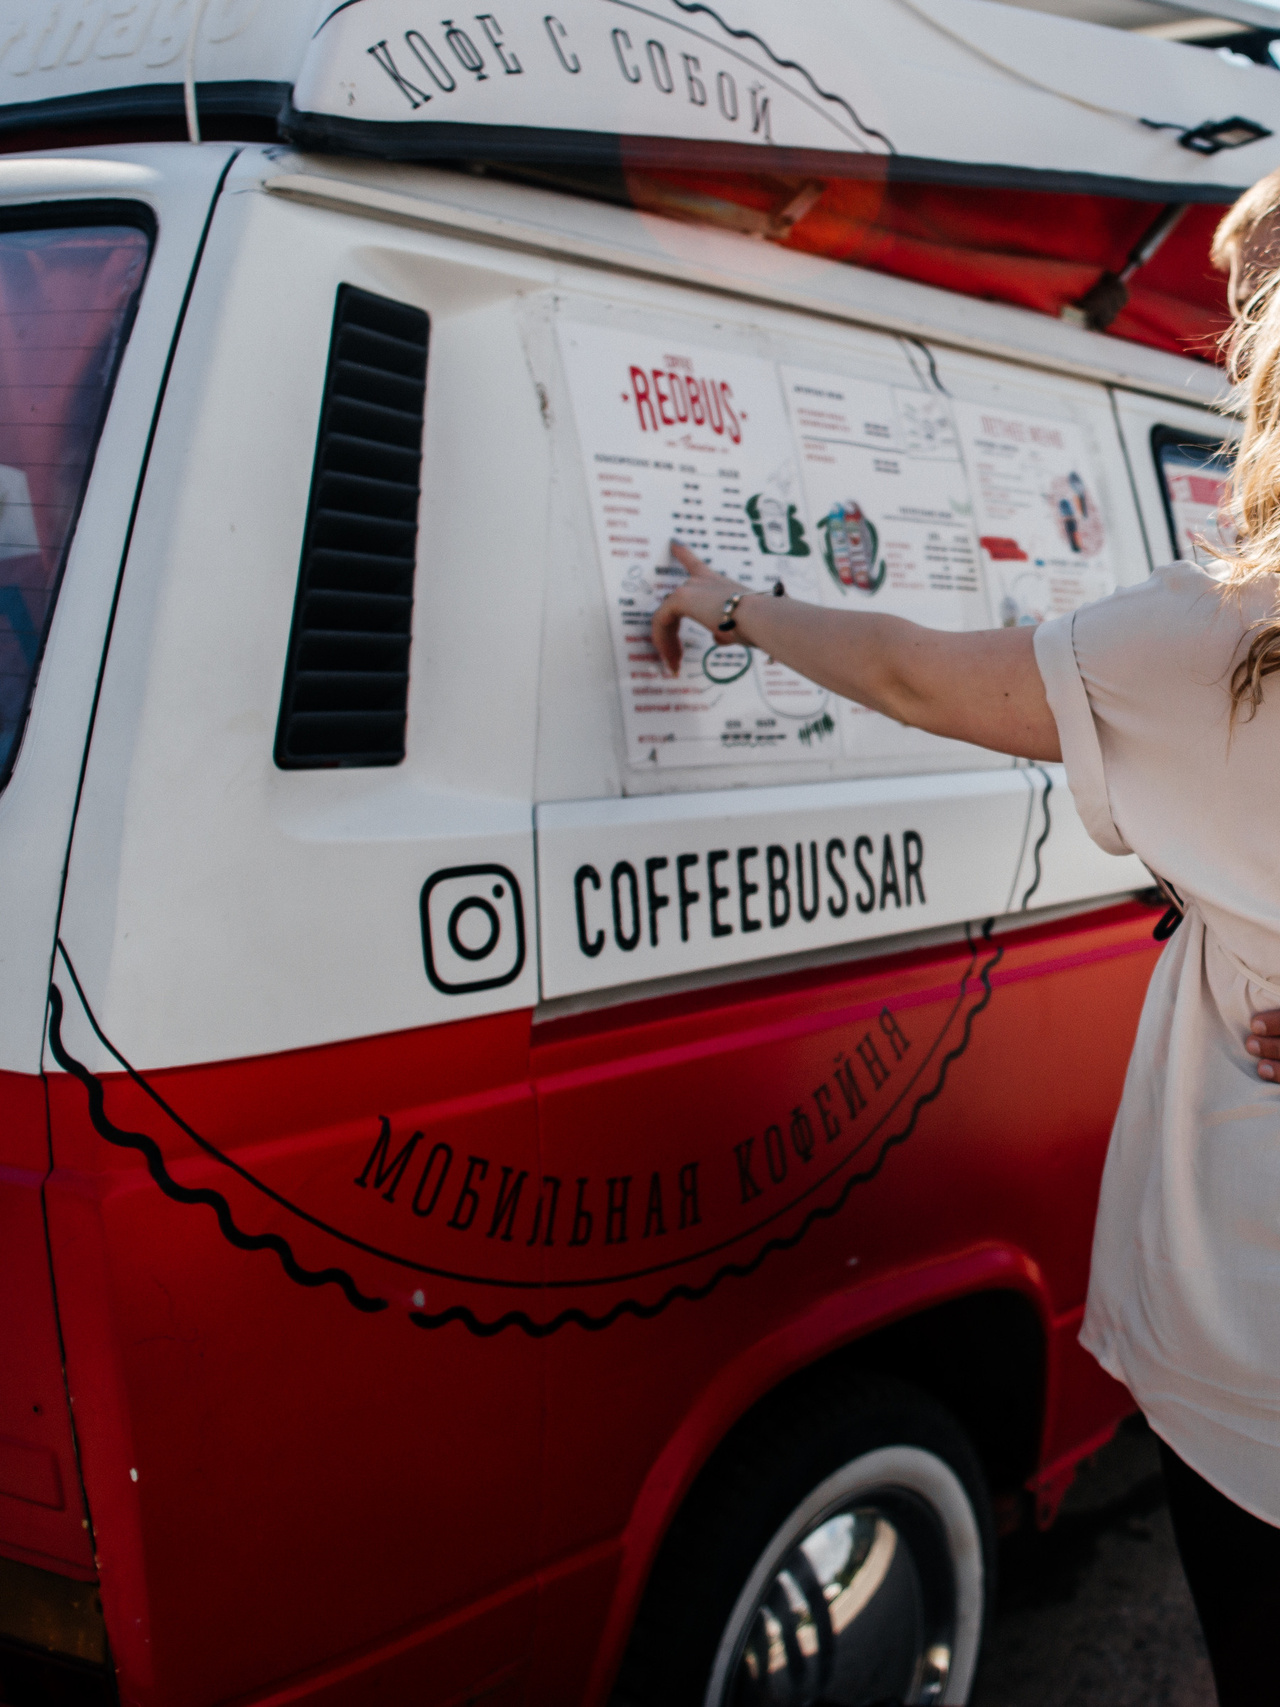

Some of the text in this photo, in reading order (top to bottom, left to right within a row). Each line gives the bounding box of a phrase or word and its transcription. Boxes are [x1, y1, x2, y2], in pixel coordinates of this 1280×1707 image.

[366, 13, 775, 145] КОФЕ С СОБОЙ
[629, 364, 742, 445] REDBUS
[573, 829, 927, 958] COFFEEBUSSAR
[353, 1005, 912, 1248] МОБИЛЬНАЯ КОФЕЙНЯ
